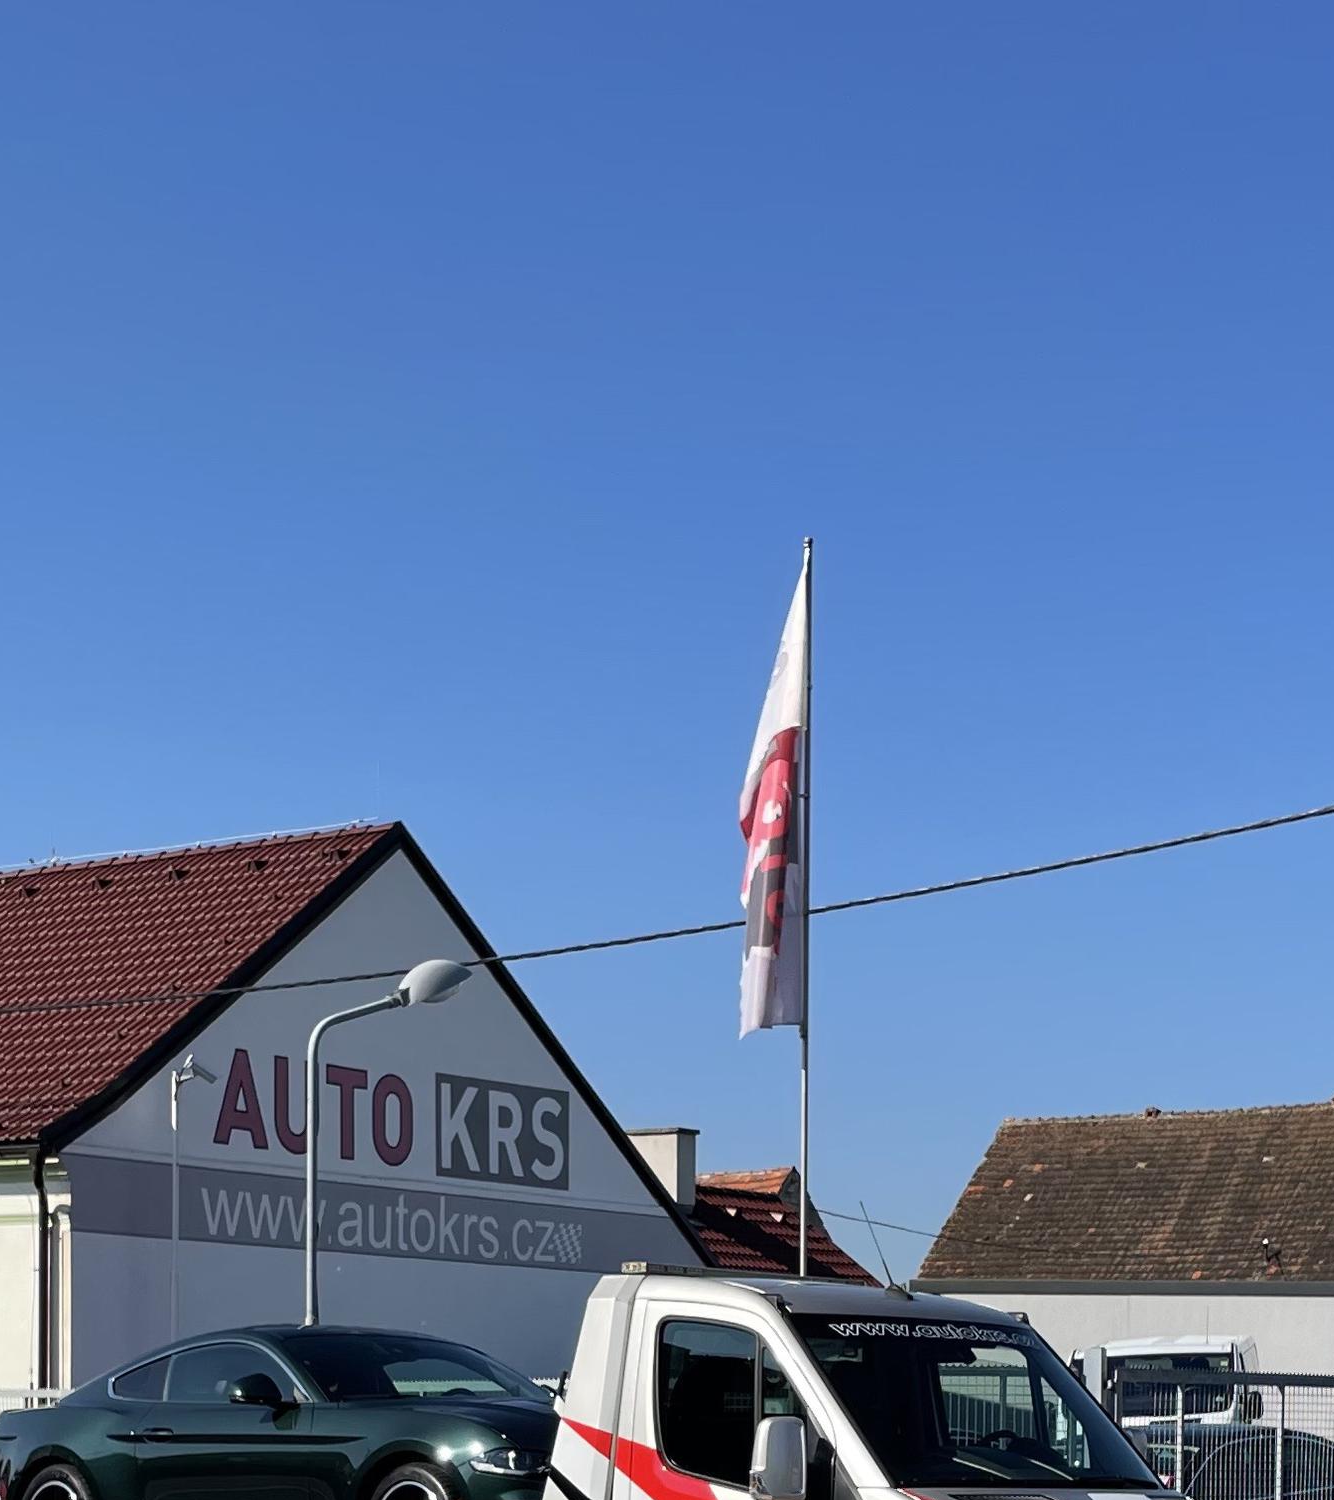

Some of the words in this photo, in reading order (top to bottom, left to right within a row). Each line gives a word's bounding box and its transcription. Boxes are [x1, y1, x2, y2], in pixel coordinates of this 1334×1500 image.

[213, 1048, 414, 1167] AUTO
[439, 1082, 564, 1181] KRS
[201, 1187, 556, 1263] www.autokrs.cz
